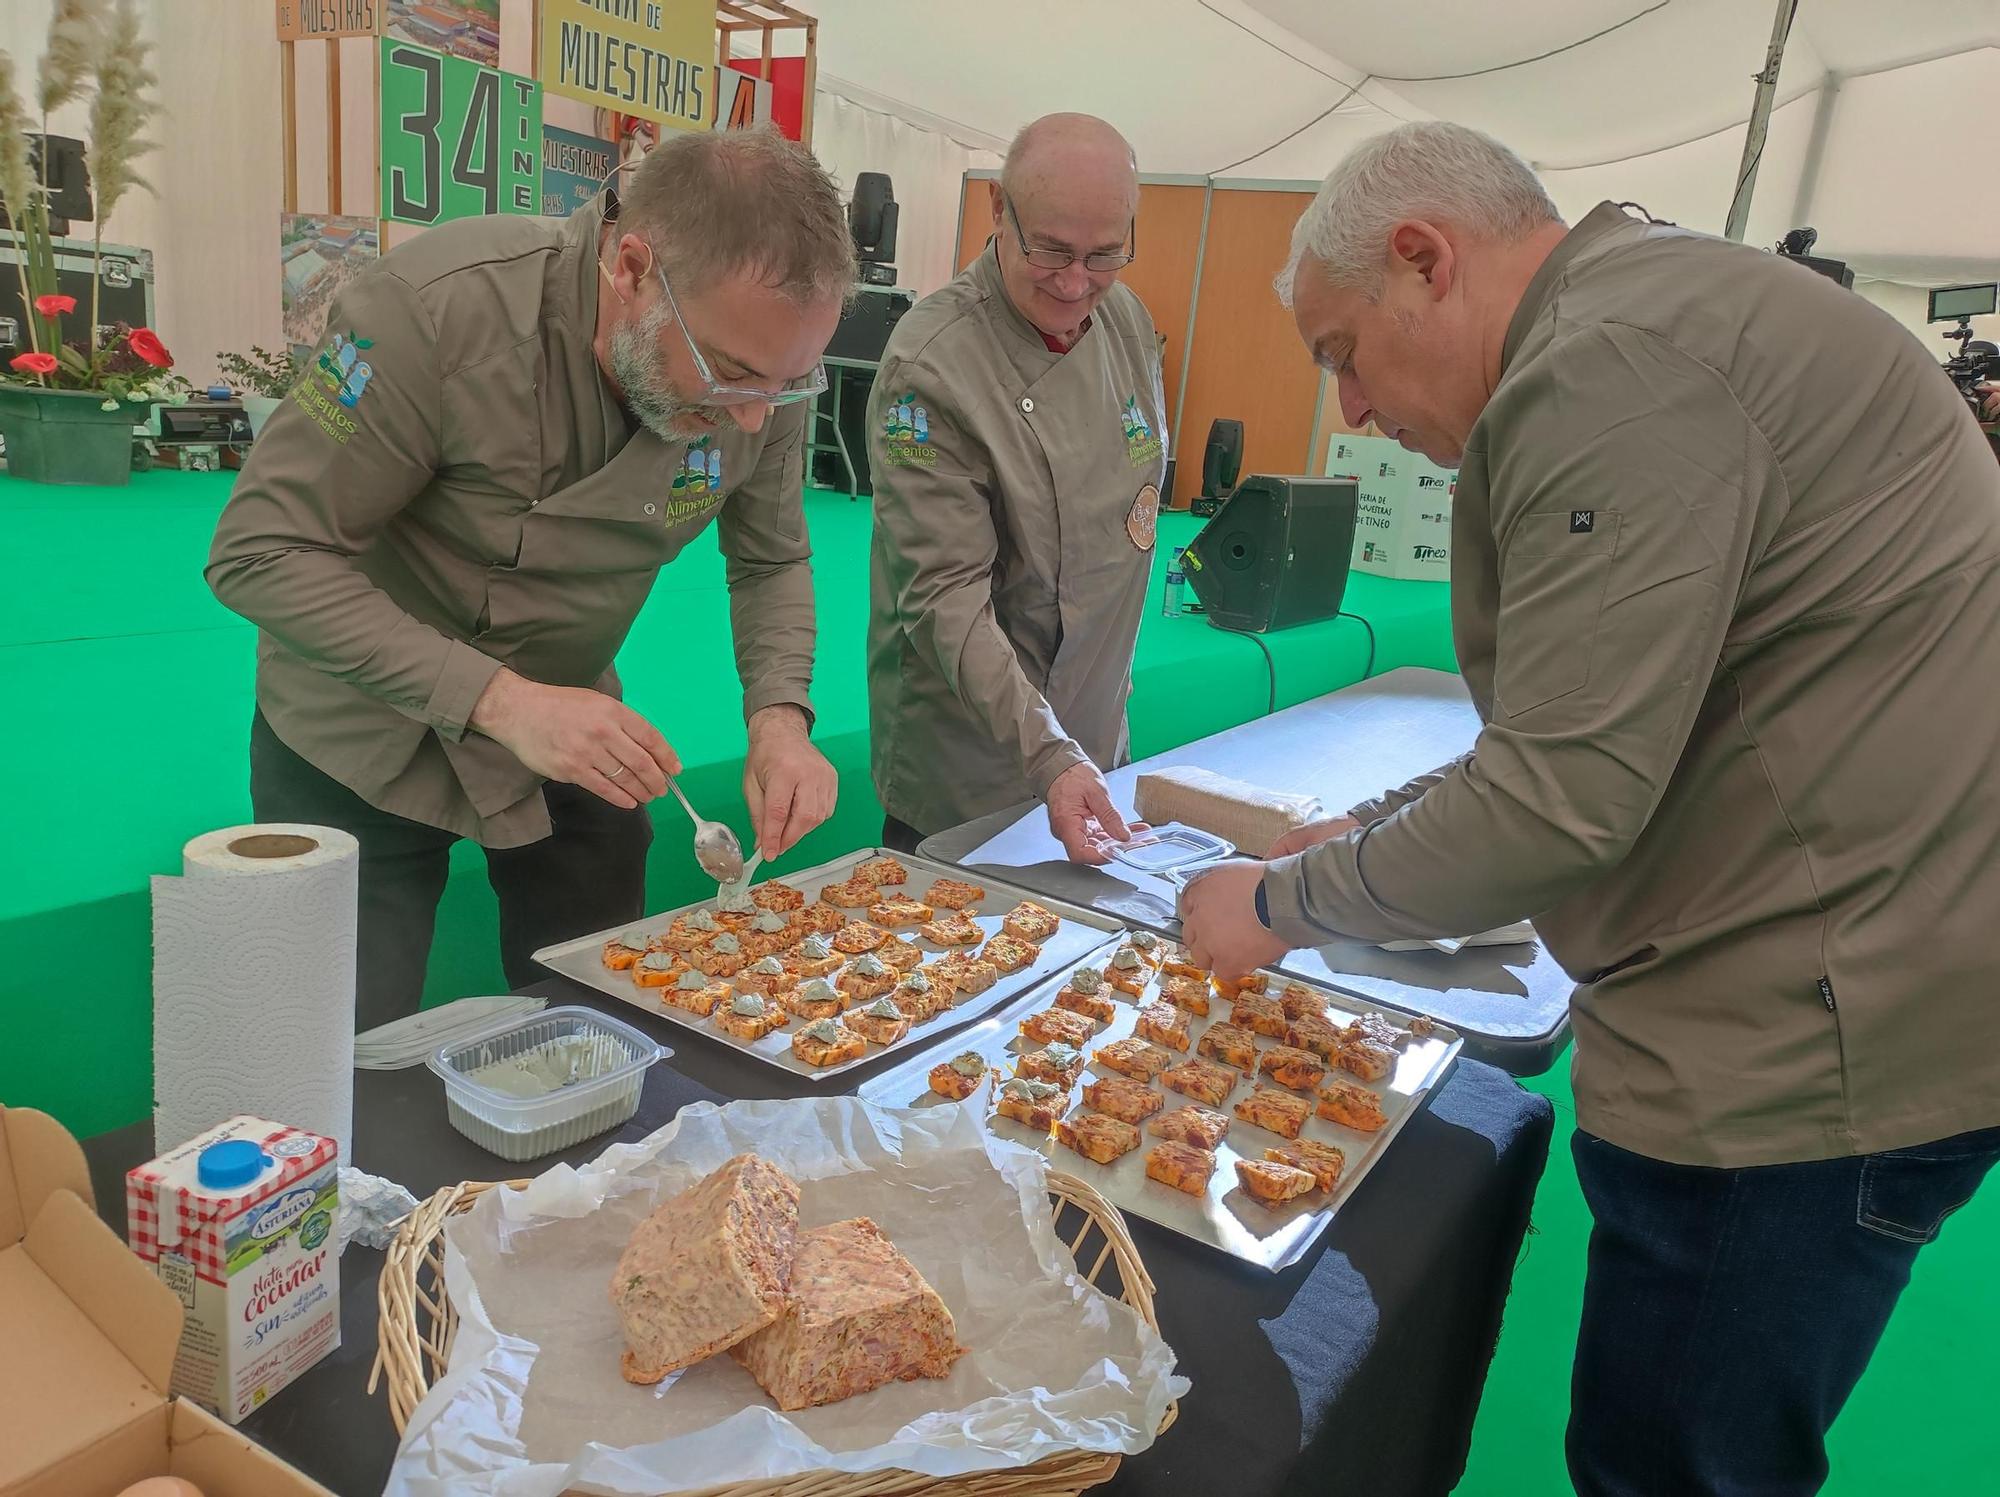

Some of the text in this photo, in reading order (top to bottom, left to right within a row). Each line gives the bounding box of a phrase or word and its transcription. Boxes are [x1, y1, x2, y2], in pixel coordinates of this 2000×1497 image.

[646, 3, 661, 31] DE
[560, 21, 704, 122] MUESTRAS
[390, 47, 502, 224] 34
[1360, 493, 1387, 505] FERIA DE
[1365, 516, 1391, 529] TINEO
[1413, 545, 1447, 562] Tineo
[252, 1266, 283, 1298] Nata
